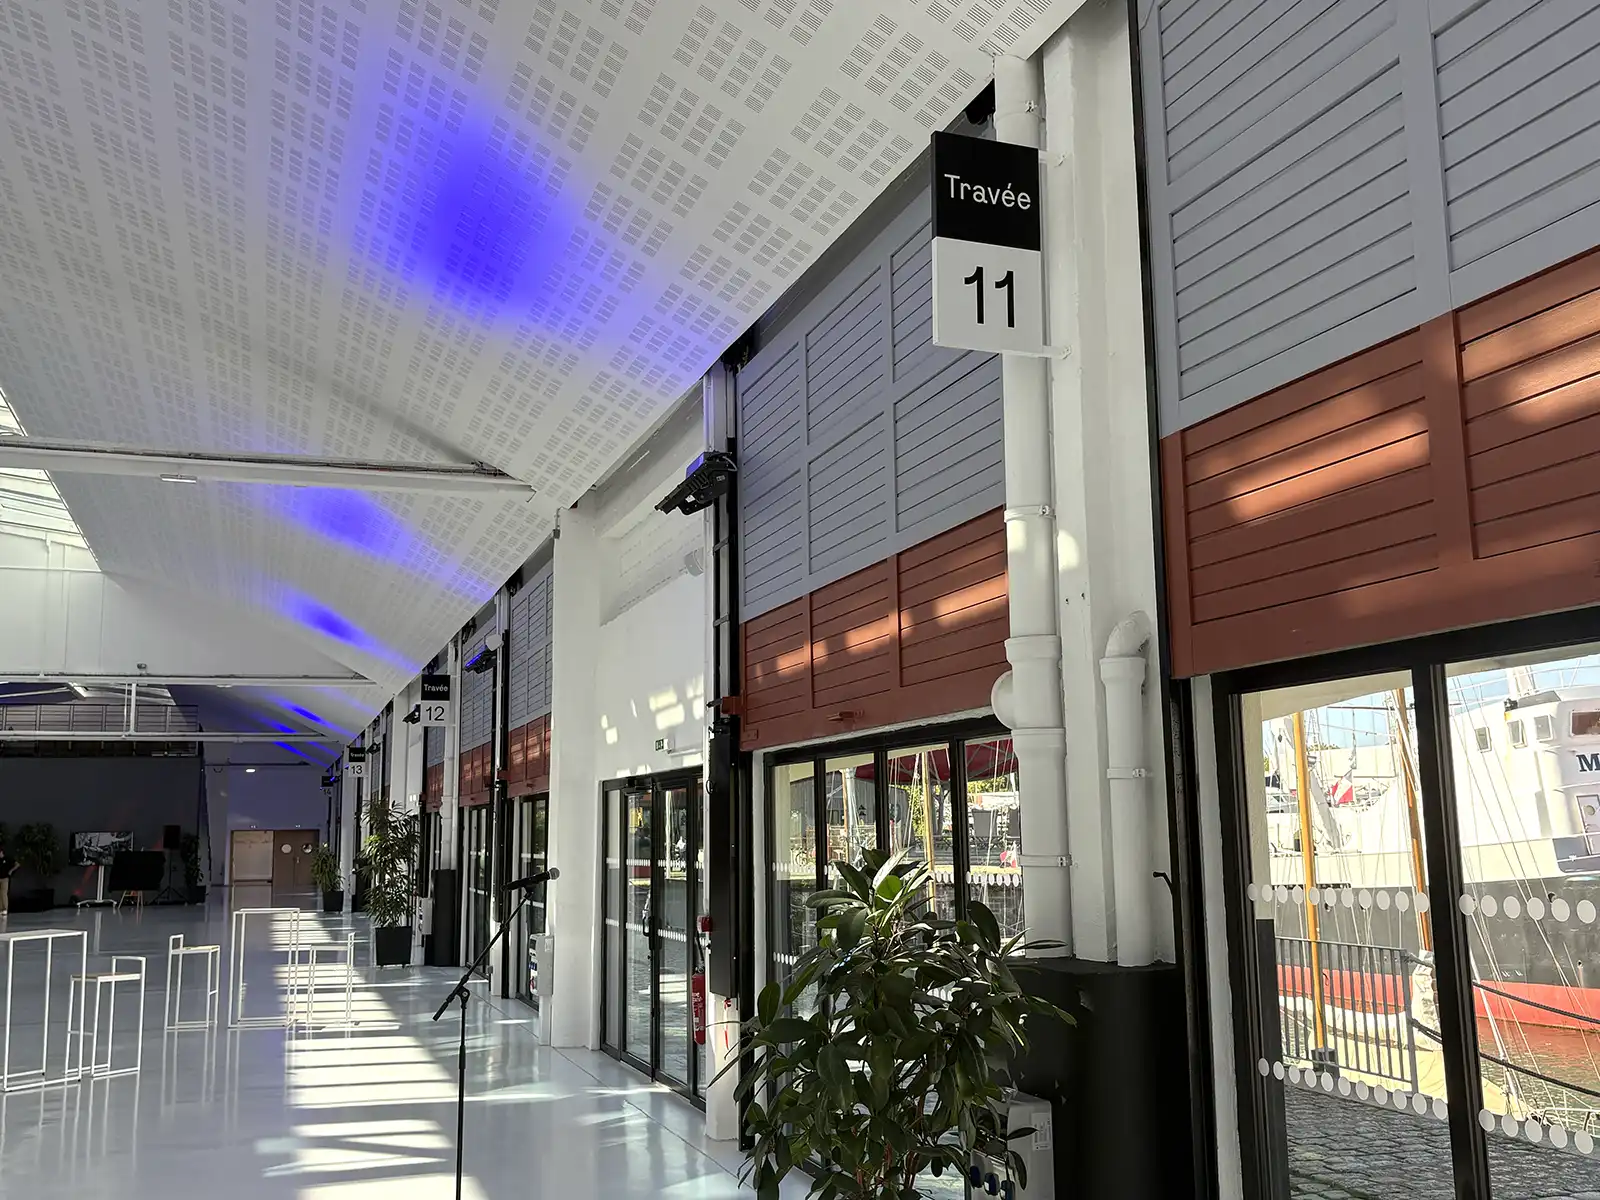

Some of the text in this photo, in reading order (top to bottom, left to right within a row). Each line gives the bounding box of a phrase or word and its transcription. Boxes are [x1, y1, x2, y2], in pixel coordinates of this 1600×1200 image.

[944, 173, 1031, 210] Travée
[964, 266, 1015, 328] 11
[423, 683, 449, 692] Travée
[426, 705, 445, 721] 12
[351, 765, 363, 774] 13
[1576, 753, 1600, 772] M
